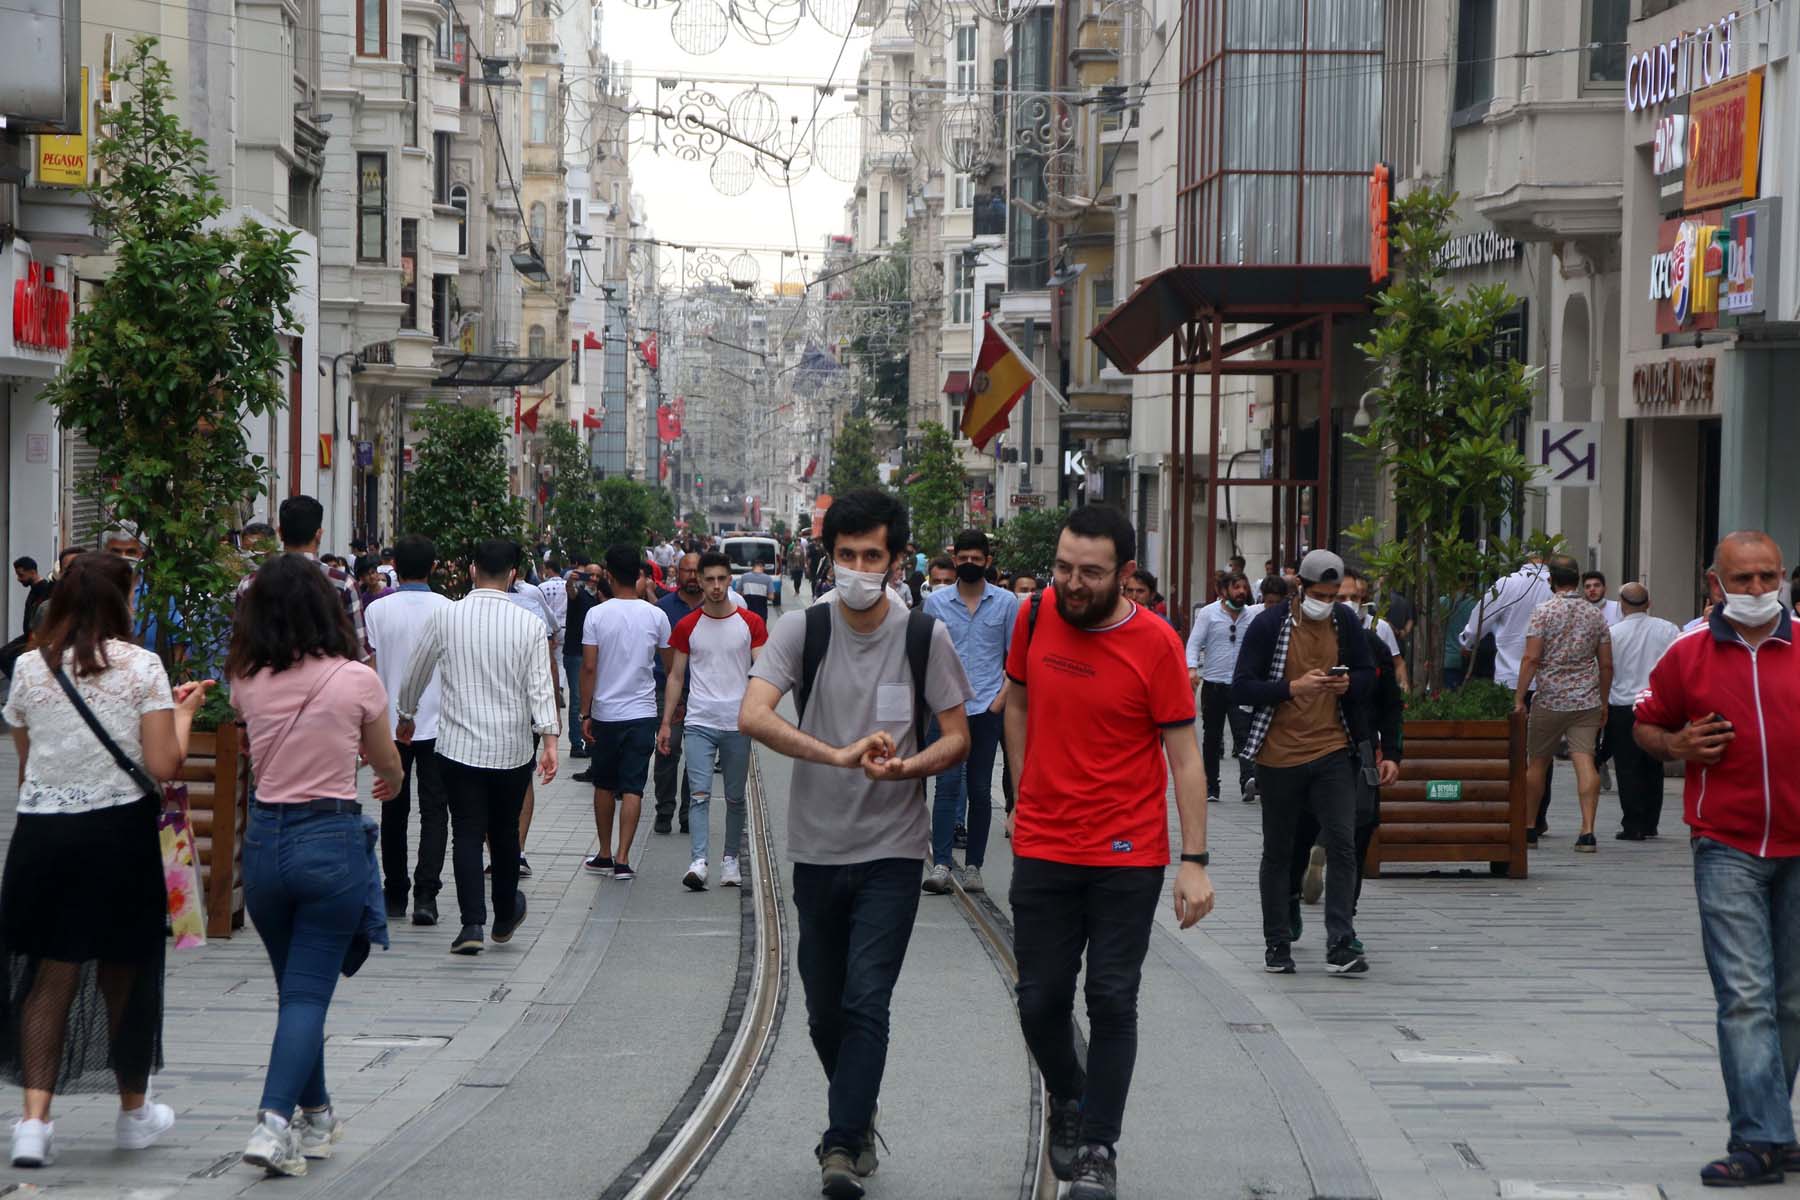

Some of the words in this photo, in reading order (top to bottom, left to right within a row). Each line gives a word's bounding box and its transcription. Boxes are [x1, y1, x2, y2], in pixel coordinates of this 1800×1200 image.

[43, 152, 84, 169] PEGASUS
[1483, 229, 1516, 264] COFFEE
[1648, 252, 1673, 300] KFC
[1633, 361, 1676, 404] GOLDEN
[1679, 358, 1715, 401] ROSE
